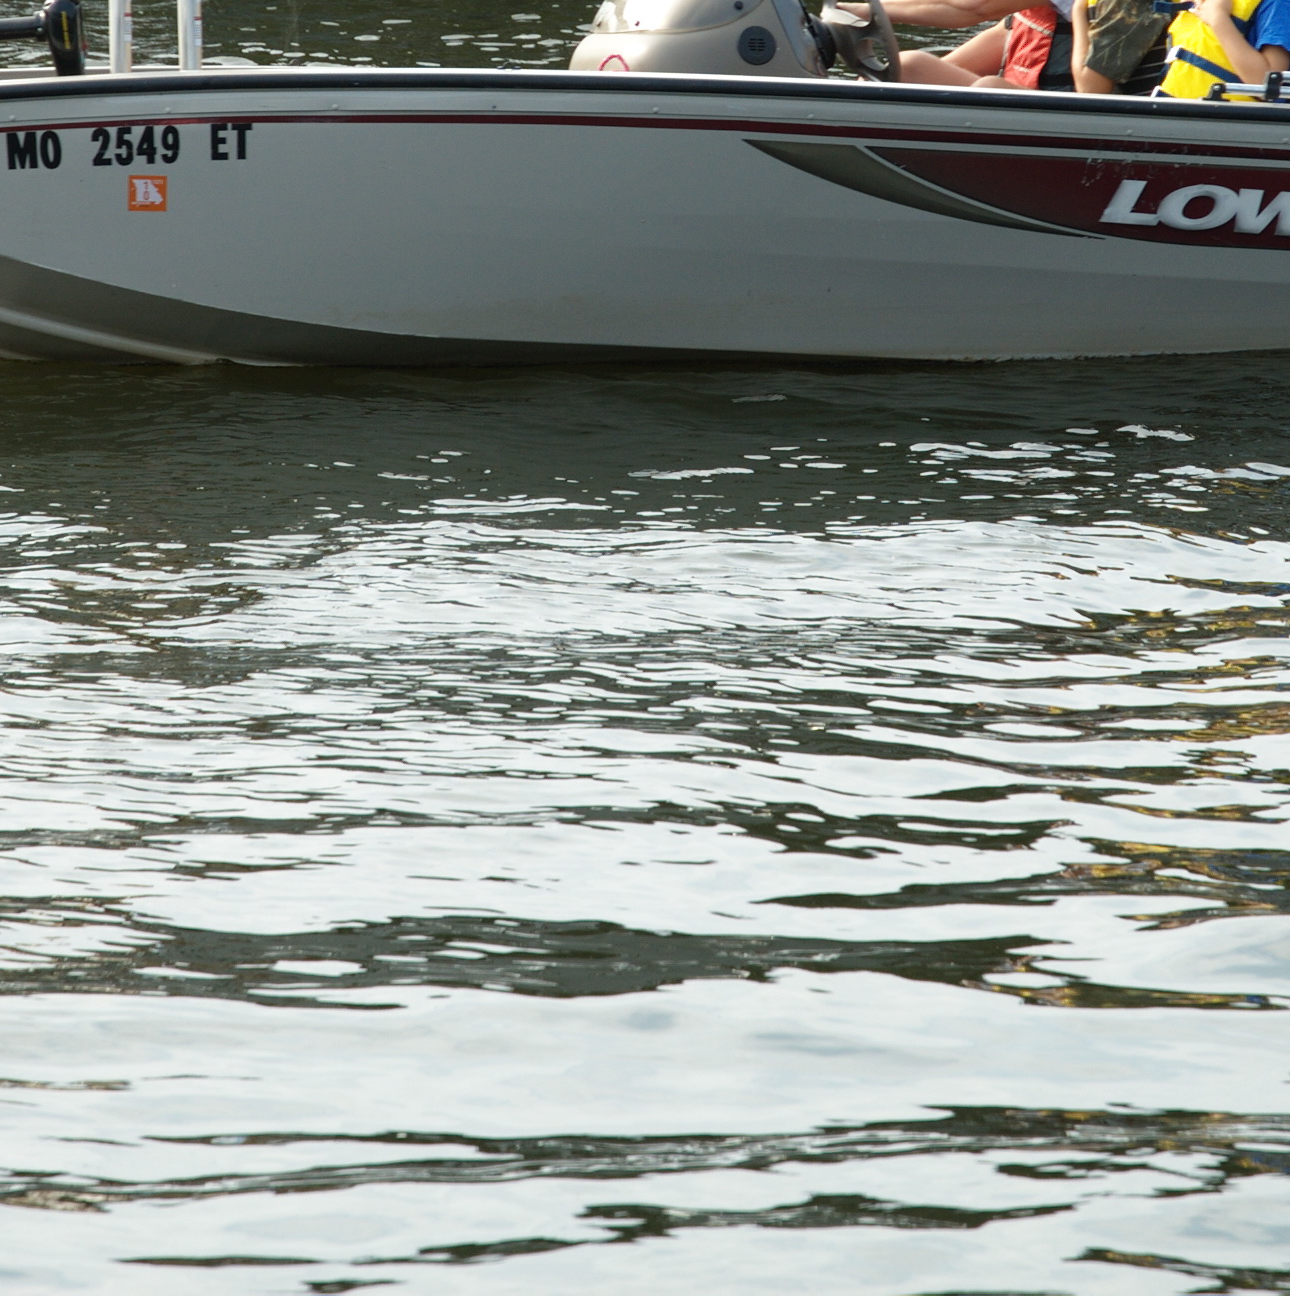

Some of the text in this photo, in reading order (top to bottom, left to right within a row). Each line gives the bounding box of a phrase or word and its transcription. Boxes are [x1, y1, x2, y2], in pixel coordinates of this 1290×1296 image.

[6, 123, 253, 170] MO 2549 ET
